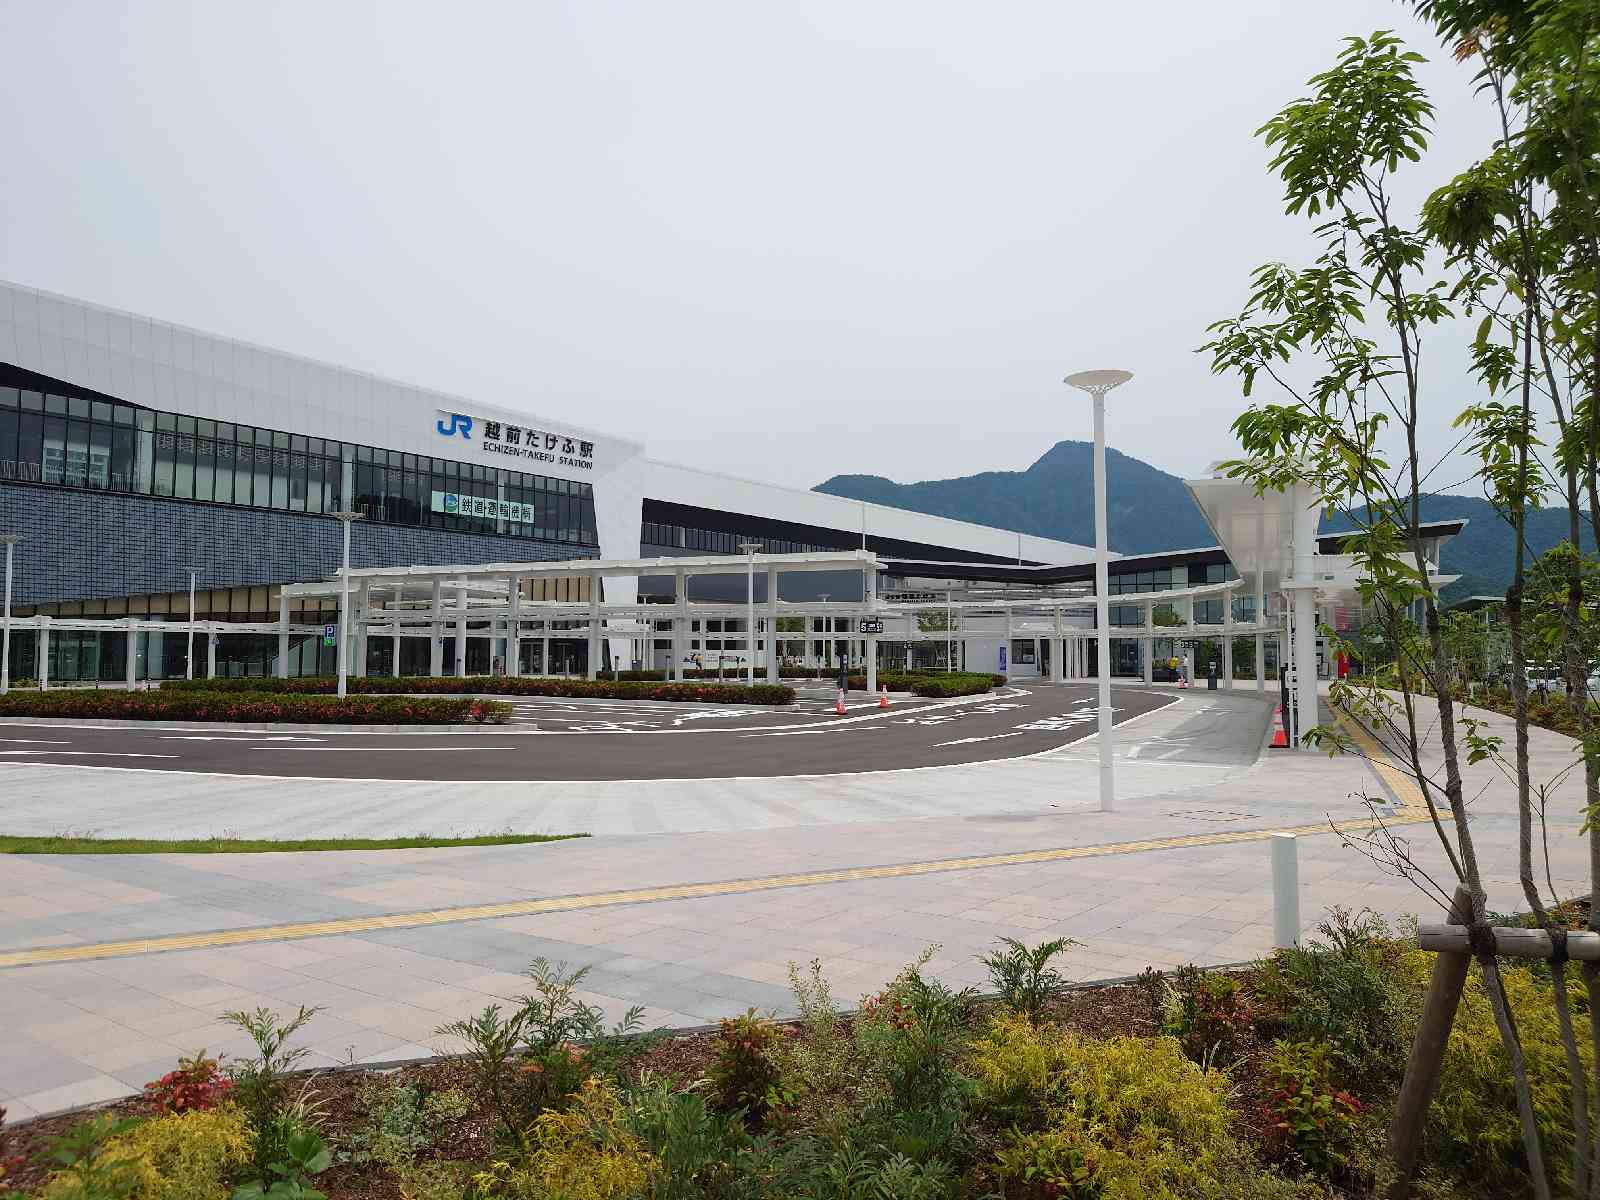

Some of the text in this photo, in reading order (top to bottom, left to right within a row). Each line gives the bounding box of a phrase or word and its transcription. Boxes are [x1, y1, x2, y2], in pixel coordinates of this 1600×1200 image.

[437, 415, 473, 440] JR
[484, 422, 593, 459] 越前たけふ駅
[483, 441, 593, 470] ECHIZEN-TAKEFU STATION
